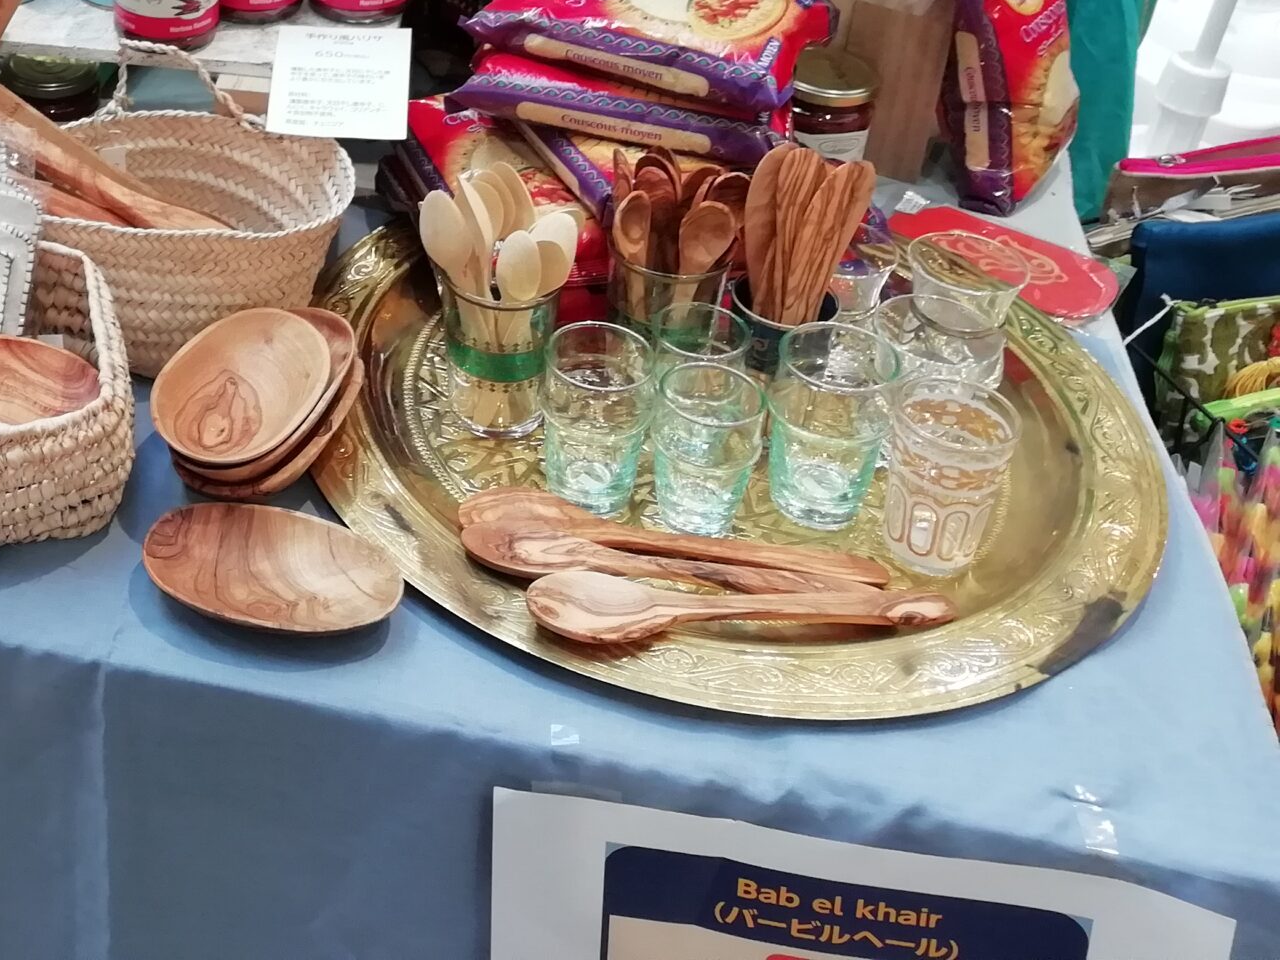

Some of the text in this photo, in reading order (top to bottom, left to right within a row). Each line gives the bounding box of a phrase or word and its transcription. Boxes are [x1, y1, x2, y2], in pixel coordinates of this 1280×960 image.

[566, 47, 663, 81] Couscous moyen
[561, 112, 663, 142] Couscous moyen
[736, 876, 944, 929] Bab el khair
[713, 901, 960, 960] (バービルヘール)
